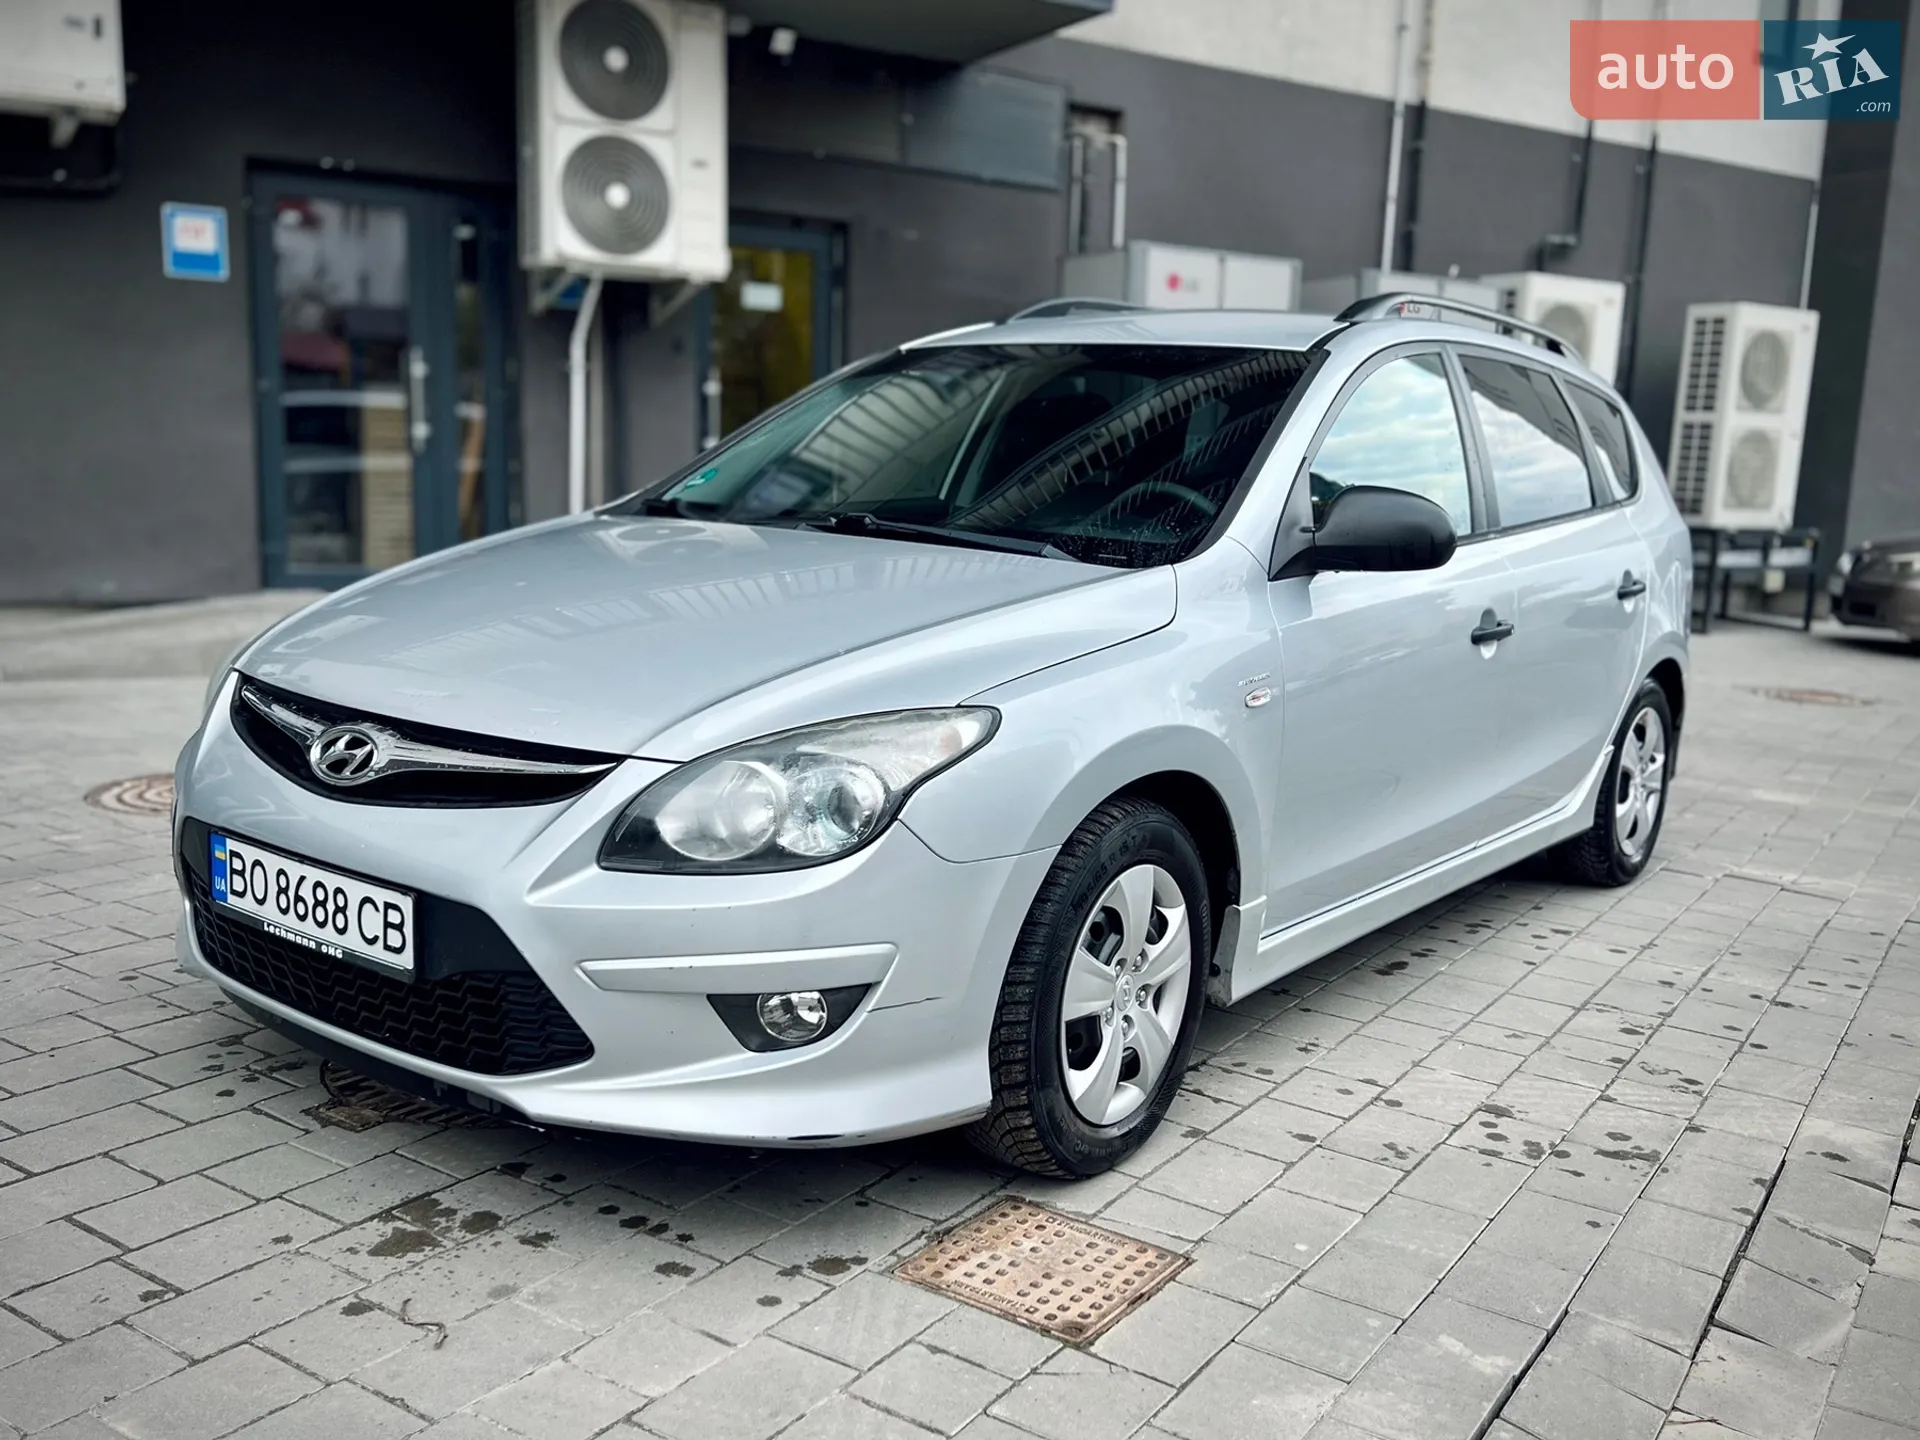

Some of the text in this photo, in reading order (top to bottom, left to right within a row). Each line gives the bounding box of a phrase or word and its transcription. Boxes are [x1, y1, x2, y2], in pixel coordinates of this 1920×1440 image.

[215, 876, 226, 892] UA
[229, 849, 407, 954] BO 8688 CB
[263, 921, 316, 949] Lechmann
